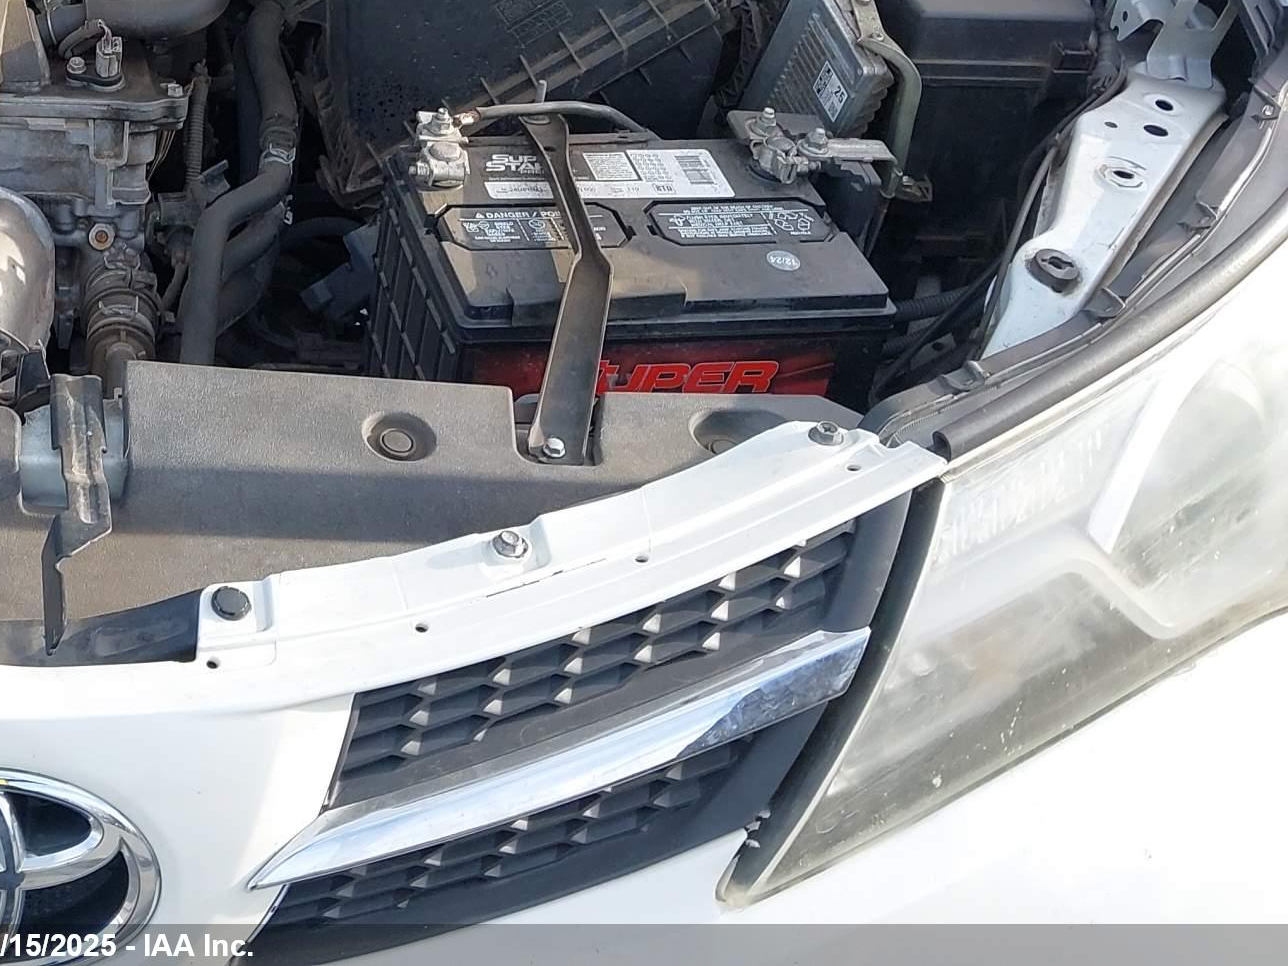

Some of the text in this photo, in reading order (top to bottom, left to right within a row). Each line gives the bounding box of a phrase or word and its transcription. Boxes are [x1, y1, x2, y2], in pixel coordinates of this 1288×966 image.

[491, 153, 538, 163] SUP
[485, 211, 531, 219] DANGER
[769, 255, 798, 266] 12/24
[595, 359, 780, 395] UPER
